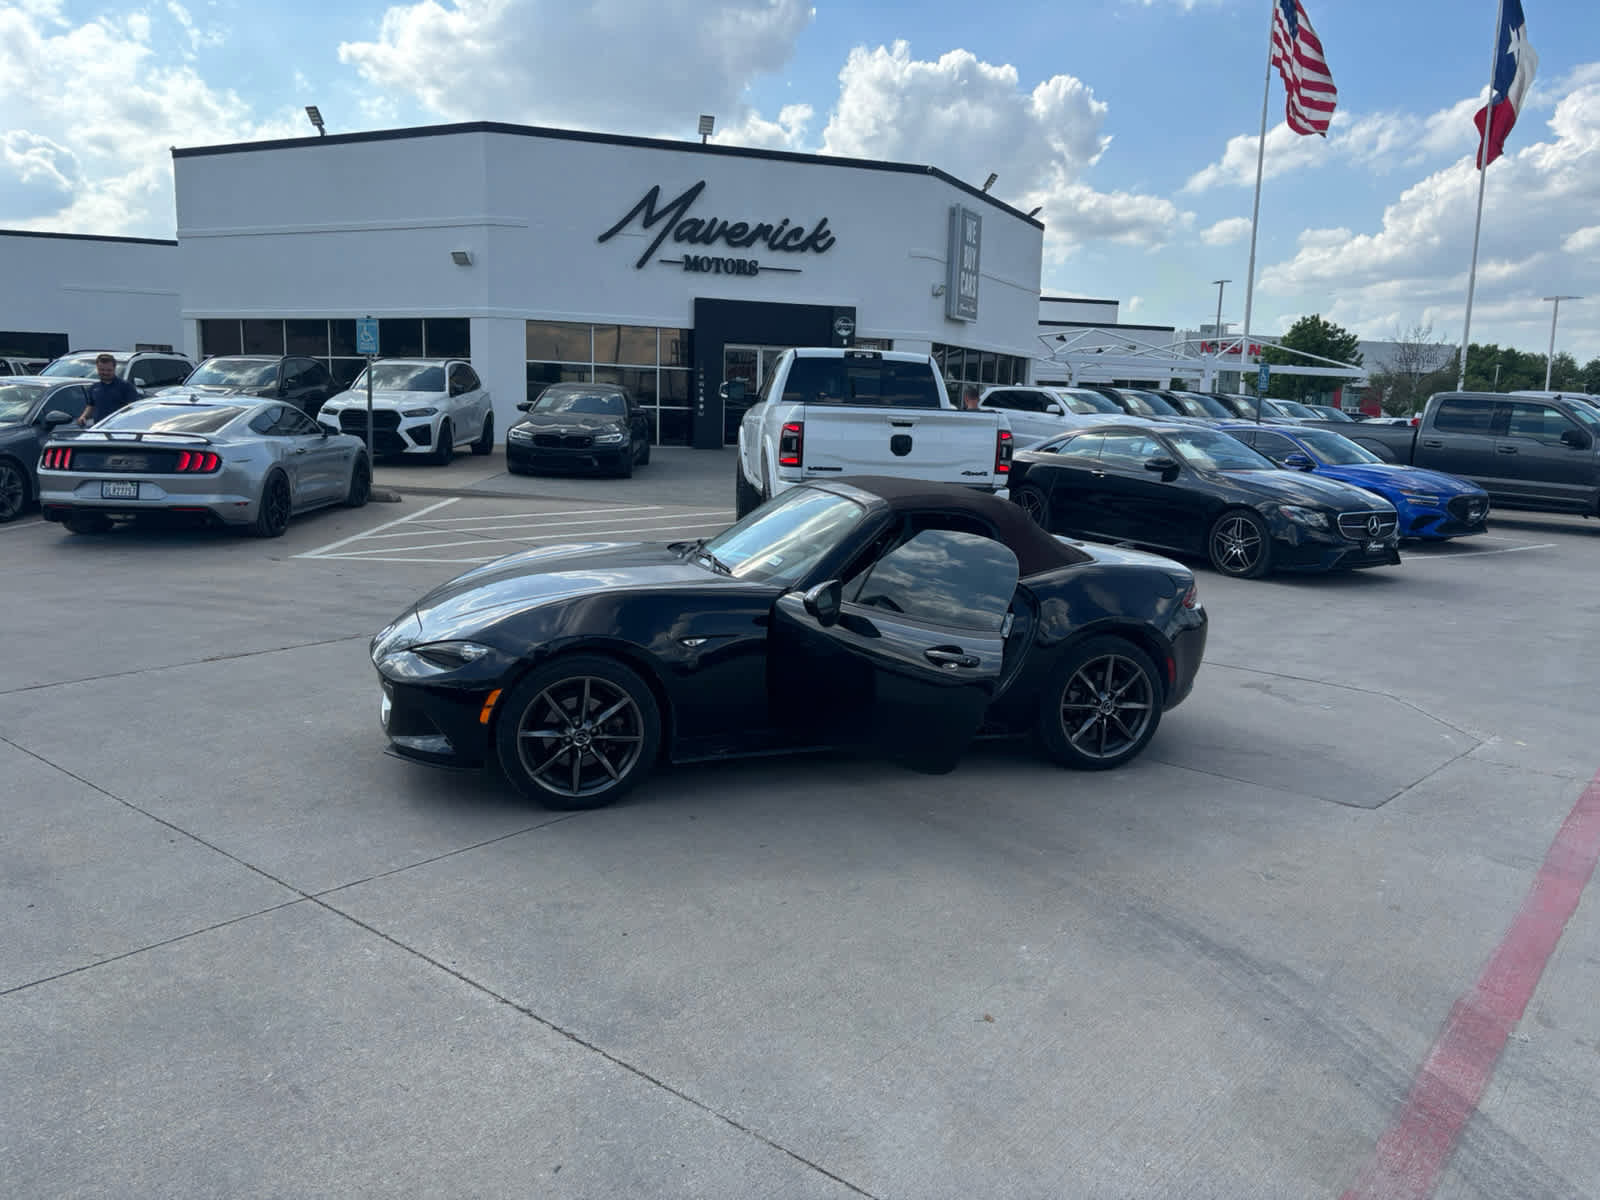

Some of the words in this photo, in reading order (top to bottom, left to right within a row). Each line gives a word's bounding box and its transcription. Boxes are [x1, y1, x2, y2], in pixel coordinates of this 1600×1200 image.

[598, 180, 836, 269] Maverick
[683, 254, 759, 276] MOTORS
[1200, 341, 1261, 355] NSSN
